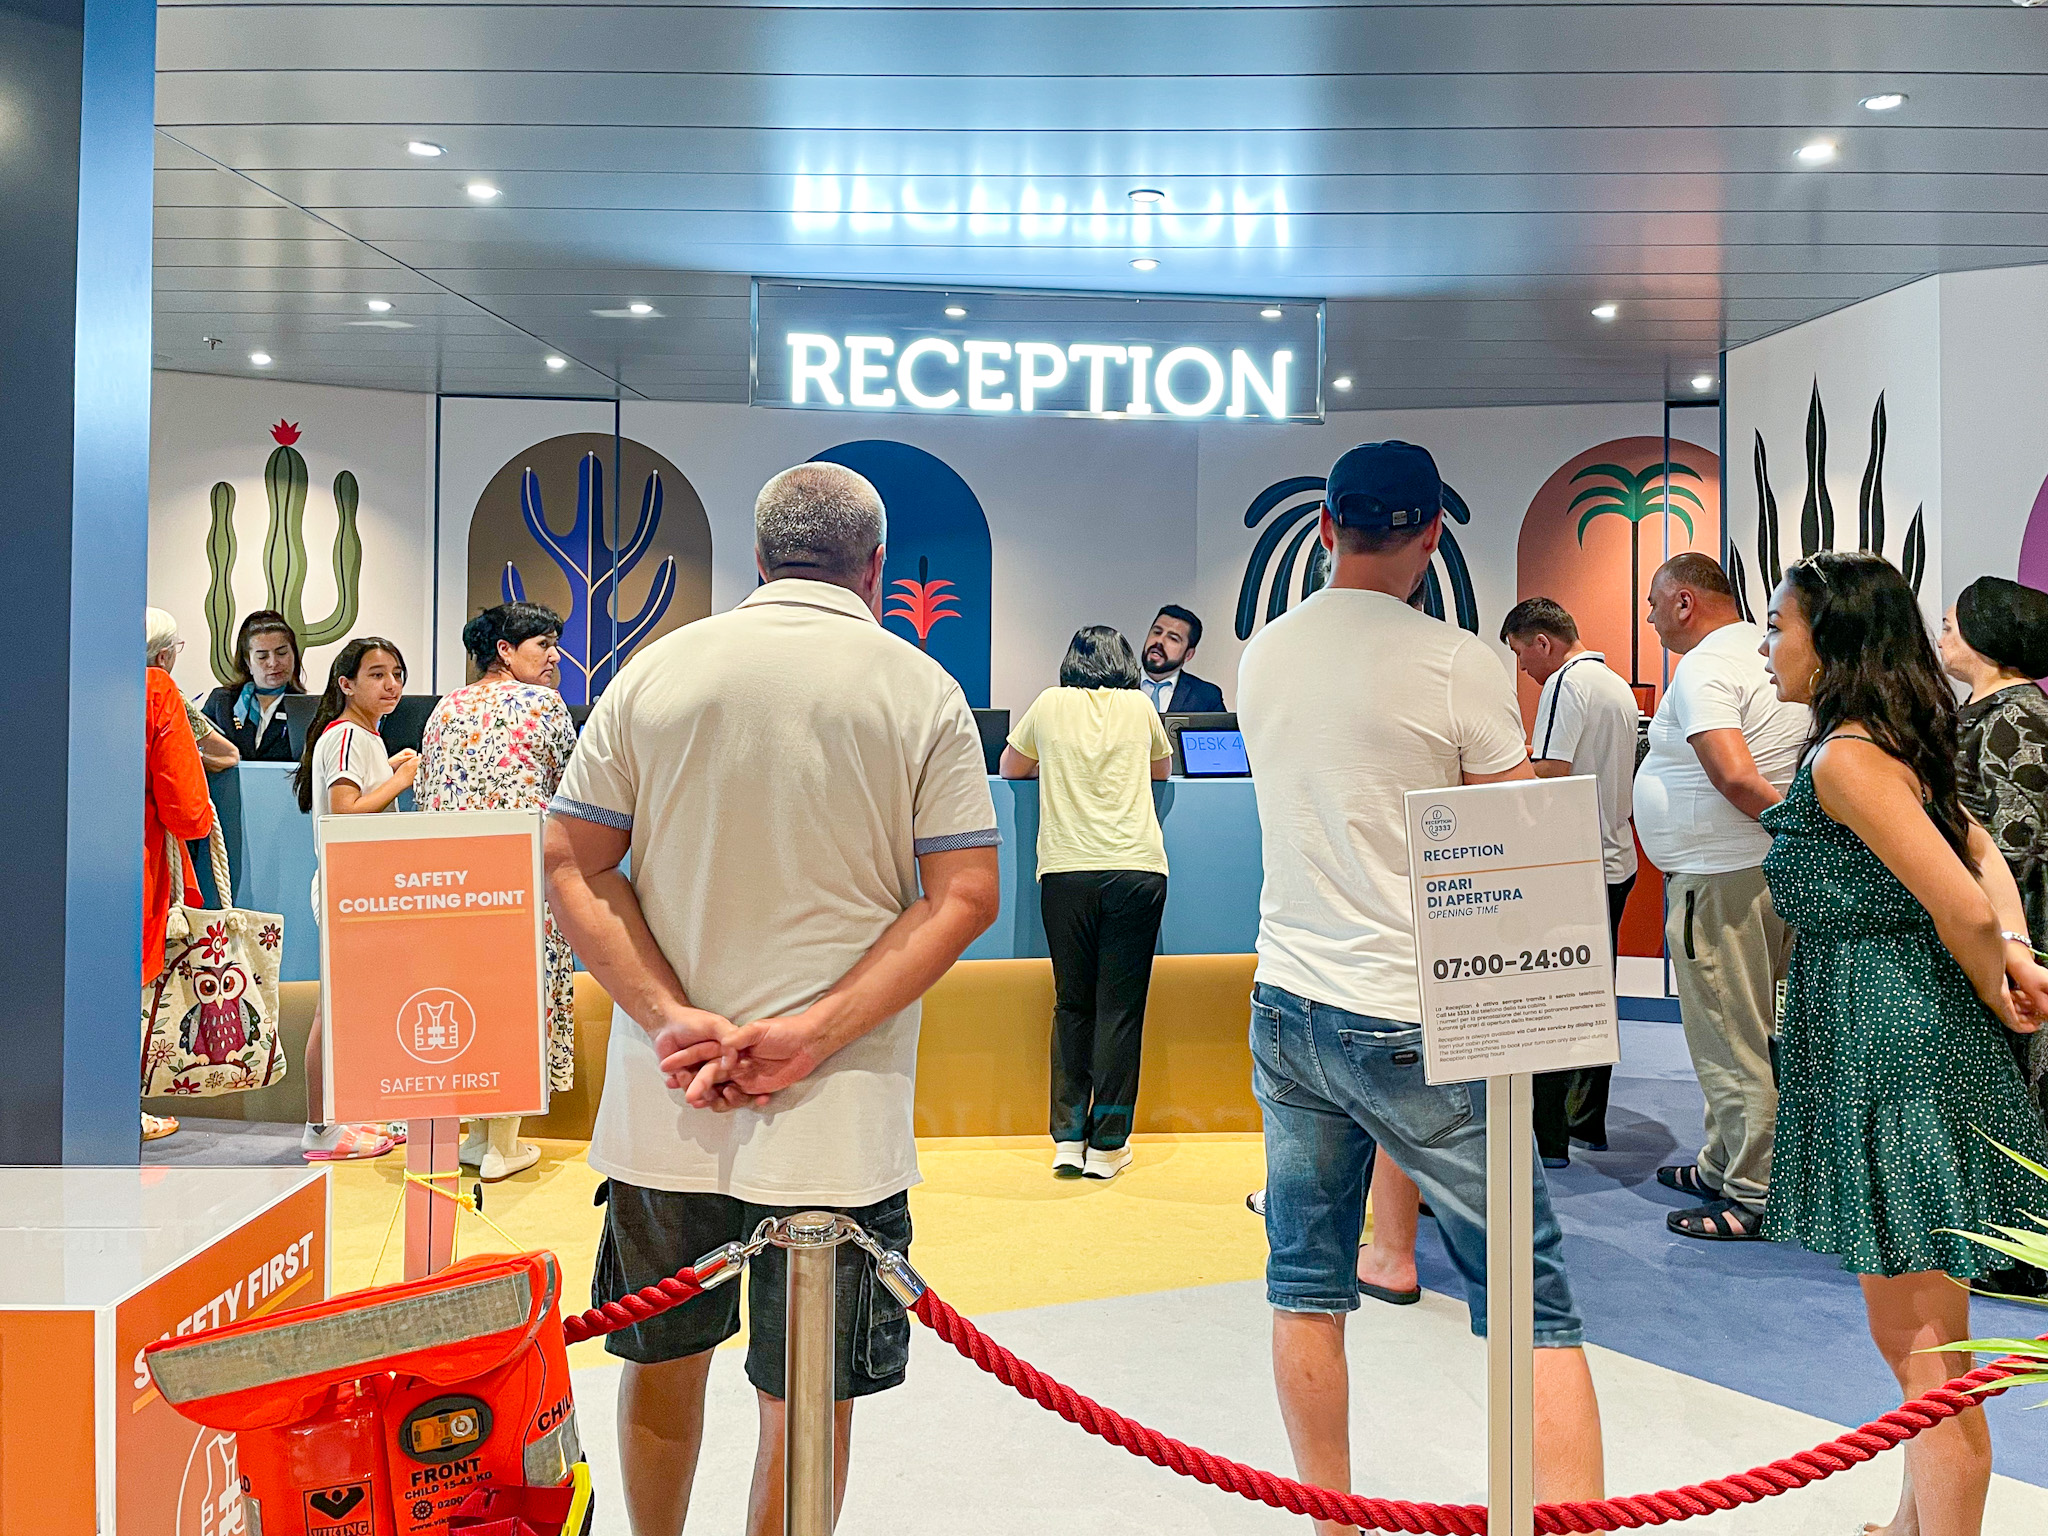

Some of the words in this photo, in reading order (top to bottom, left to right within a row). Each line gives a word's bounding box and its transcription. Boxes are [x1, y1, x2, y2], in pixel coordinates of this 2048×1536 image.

[786, 332, 1293, 418] RECEPTION
[1185, 737, 1227, 751] DESK
[1232, 736, 1242, 750] 4
[1424, 844, 1504, 862] RECEPTION
[394, 870, 468, 888] SAFETY
[1426, 878, 1472, 893] ORARI
[338, 892, 461, 914] COLLECTING
[465, 890, 525, 908] POINT
[1427, 896, 1442, 908] DI
[1446, 888, 1523, 907] APERTURA
[1428, 907, 1473, 920] OPENING
[1476, 905, 1499, 915] TIME
[380, 1075, 446, 1094] SAFETY
[452, 1071, 500, 1090] FIRST
[133, 1279, 243, 1390] SFETY
[248, 1230, 314, 1310] FIRST
[537, 1385, 573, 1432] CHIL
[411, 1457, 481, 1487] FRONT
[404, 1484, 439, 1500] CHILD
[443, 1475, 473, 1490] 15-43
[476, 1471, 493, 1482] KG
[311, 1520, 369, 1536] VIKING
